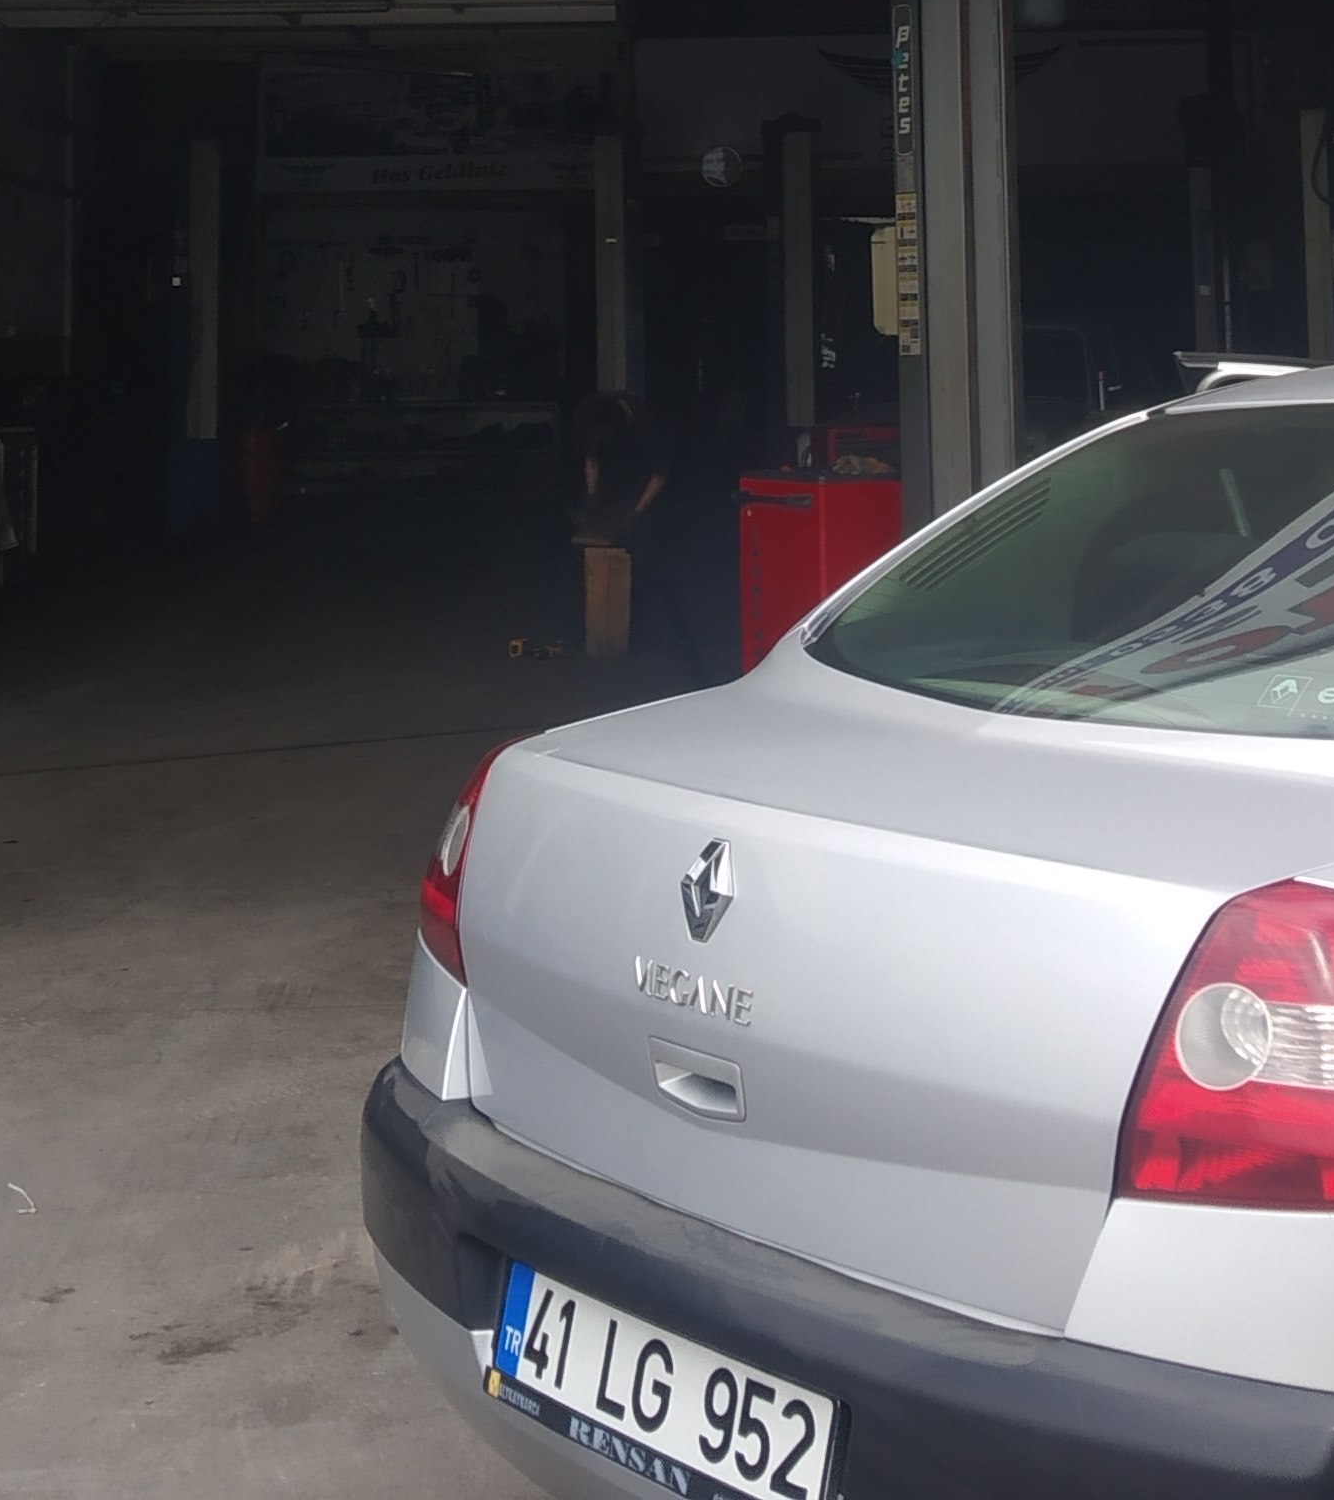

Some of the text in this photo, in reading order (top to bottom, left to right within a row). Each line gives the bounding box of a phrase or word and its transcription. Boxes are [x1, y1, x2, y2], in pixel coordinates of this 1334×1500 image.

[633, 954, 755, 1027] MEGANE
[504, 1323, 523, 1358] TR
[523, 1288, 816, 1500] 41 LG 952
[568, 1414, 692, 1498] RENSAN
